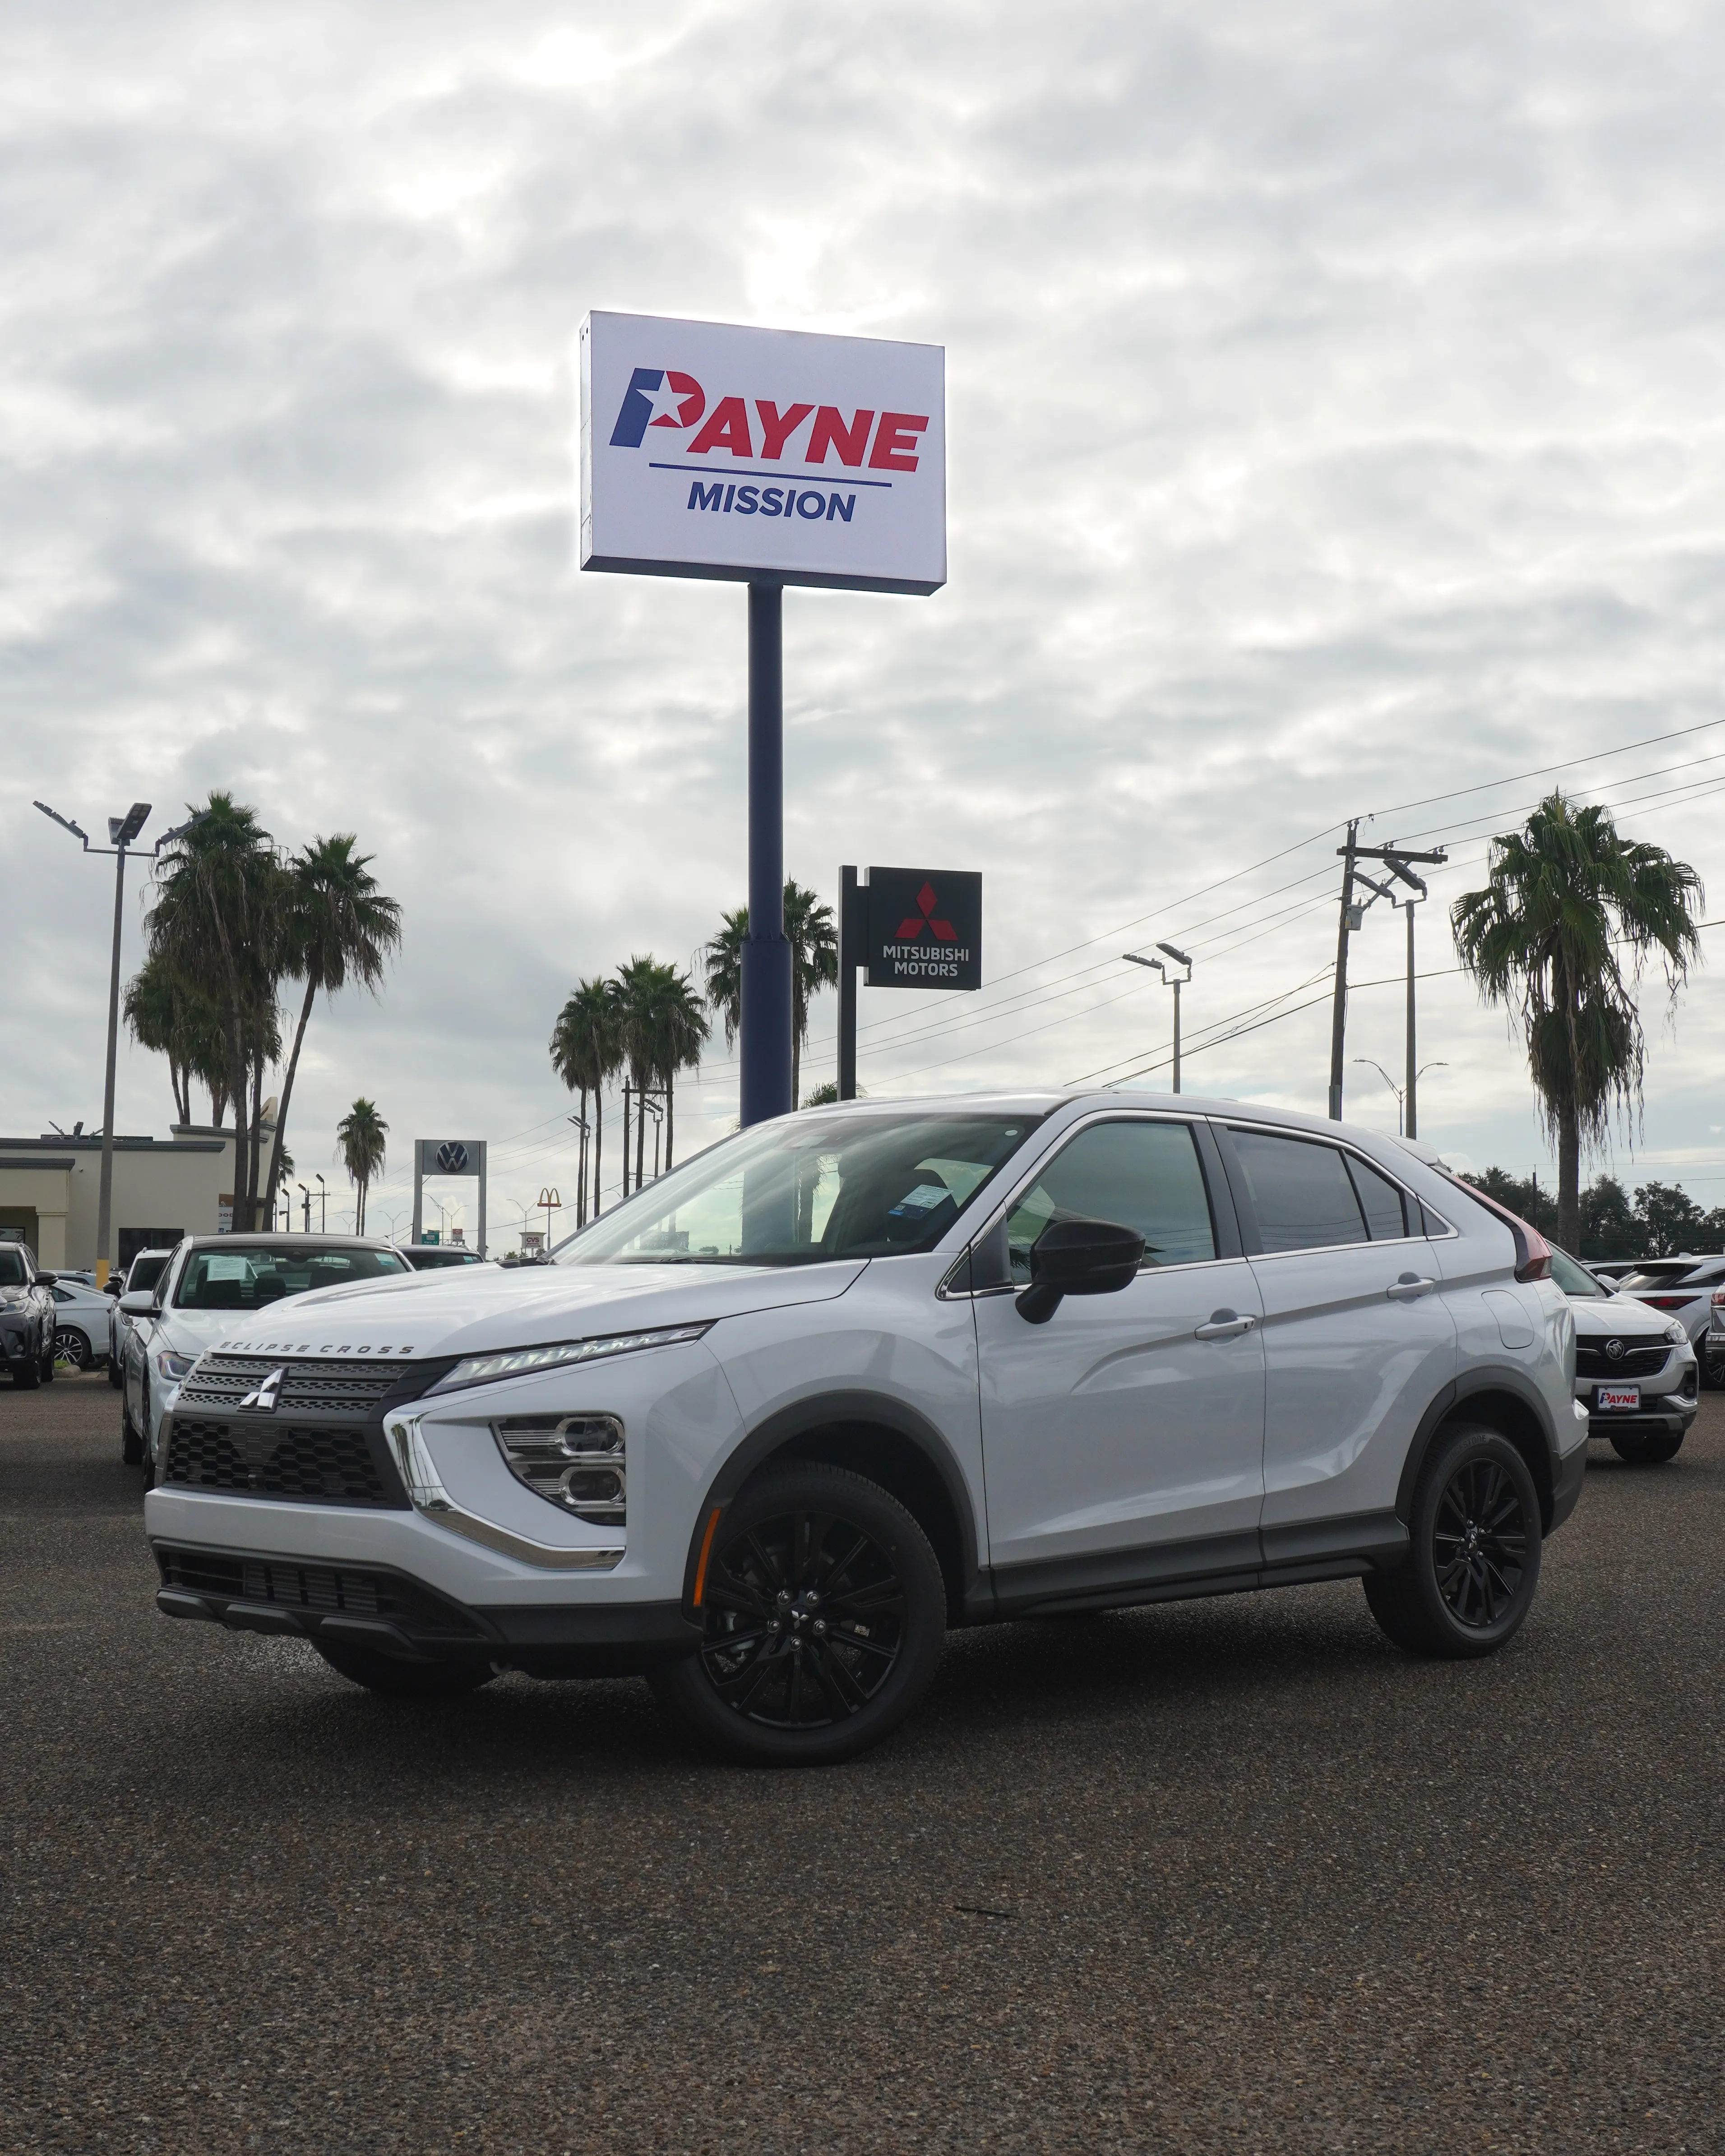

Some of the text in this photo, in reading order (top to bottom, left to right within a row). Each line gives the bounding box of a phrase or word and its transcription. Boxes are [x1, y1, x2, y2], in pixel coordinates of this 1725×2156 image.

[609, 367, 930, 472] PAYNE
[687, 481, 856, 522] MISSION
[883, 946, 969, 961] MITSUBISHI
[895, 962, 957, 976] MOTORS
[219, 1341, 415, 1354] ECLIPSE CROSS
[1599, 1392, 1637, 1403] PAYNE
